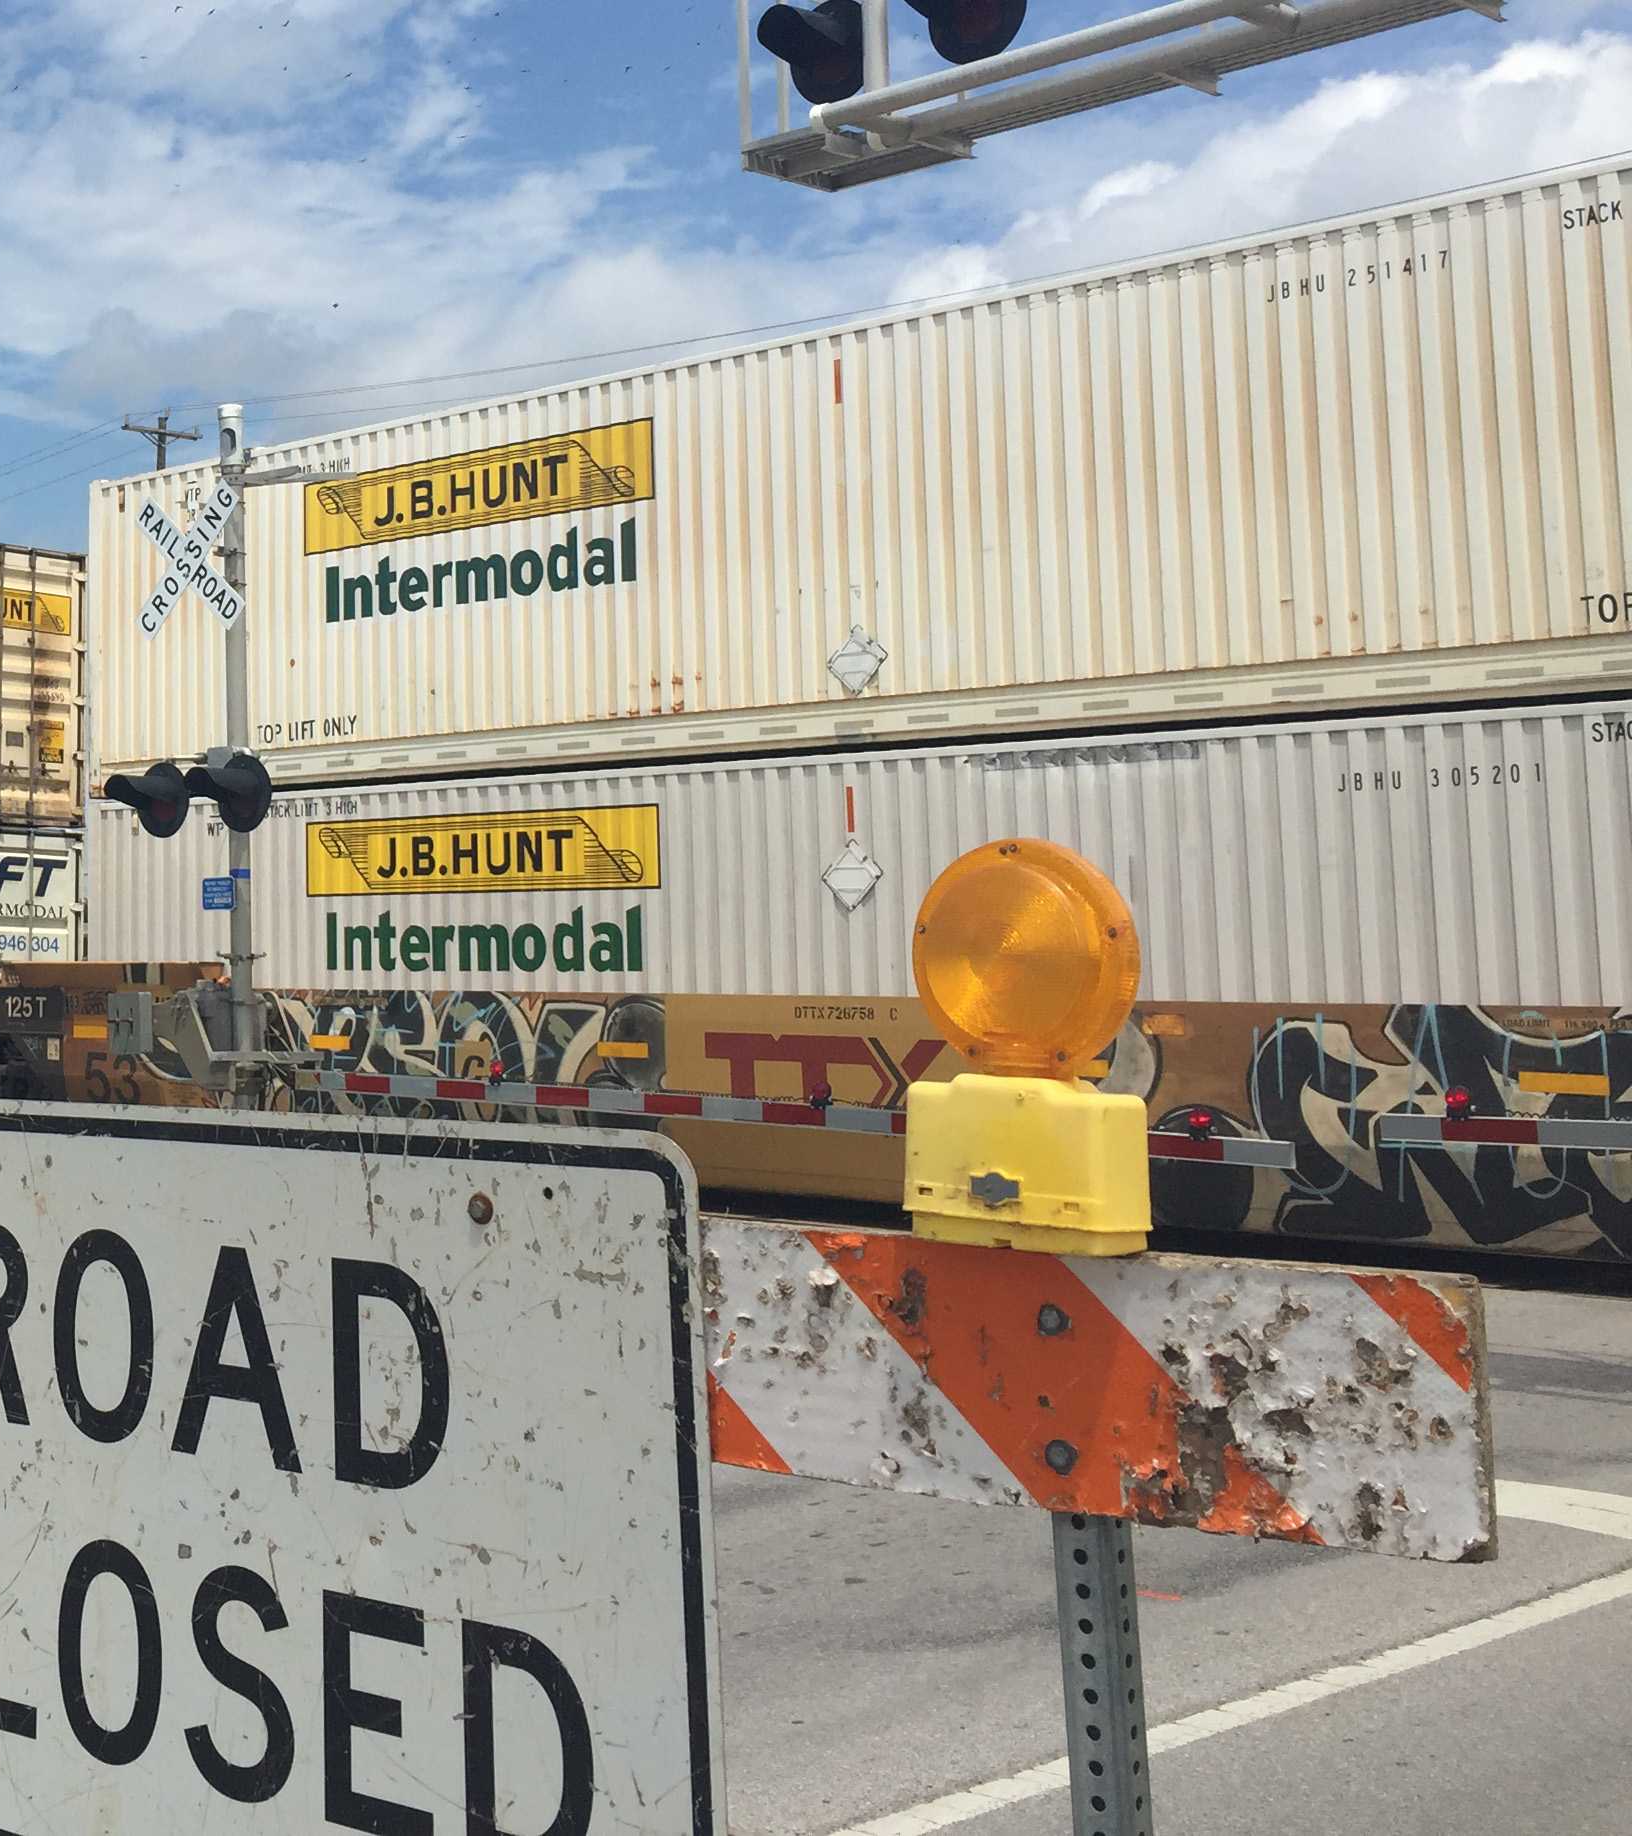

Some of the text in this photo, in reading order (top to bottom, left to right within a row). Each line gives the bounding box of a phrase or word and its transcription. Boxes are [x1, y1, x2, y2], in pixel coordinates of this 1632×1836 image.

[1563, 200, 1623, 230] STACK
[1266, 249, 1450, 303] JBHU 251417
[140, 486, 234, 634] CROSSING
[325, 516, 638, 624] Intermodal
[257, 715, 357, 745] TOP LIFT ONLY
[1337, 762, 1542, 793] JBHU 305201
[326, 802, 332, 816] 3
[325, 904, 644, 973] Intermodal
[84, 1051, 140, 1104] 53
